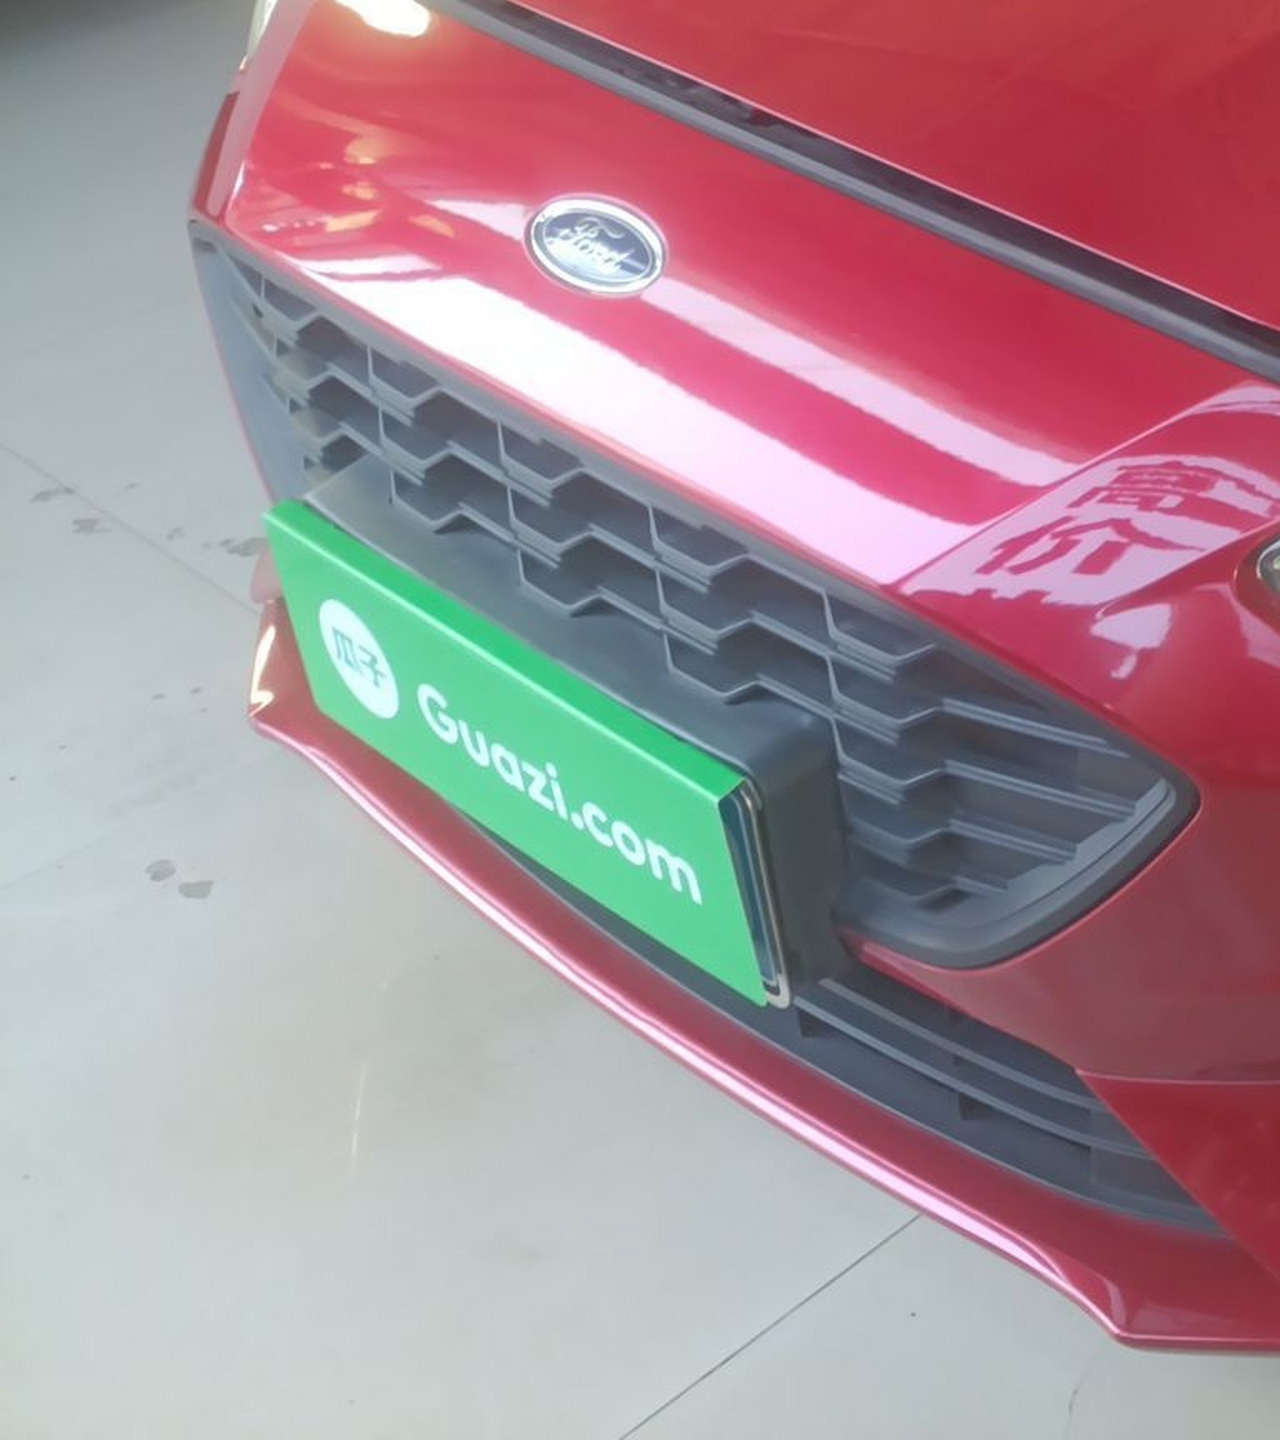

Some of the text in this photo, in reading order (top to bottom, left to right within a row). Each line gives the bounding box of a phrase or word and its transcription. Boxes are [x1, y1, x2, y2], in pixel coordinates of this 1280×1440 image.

[556, 216, 640, 275] Ford
[331, 626, 387, 688] 瓜子
[417, 683, 703, 905] Guazi.com
